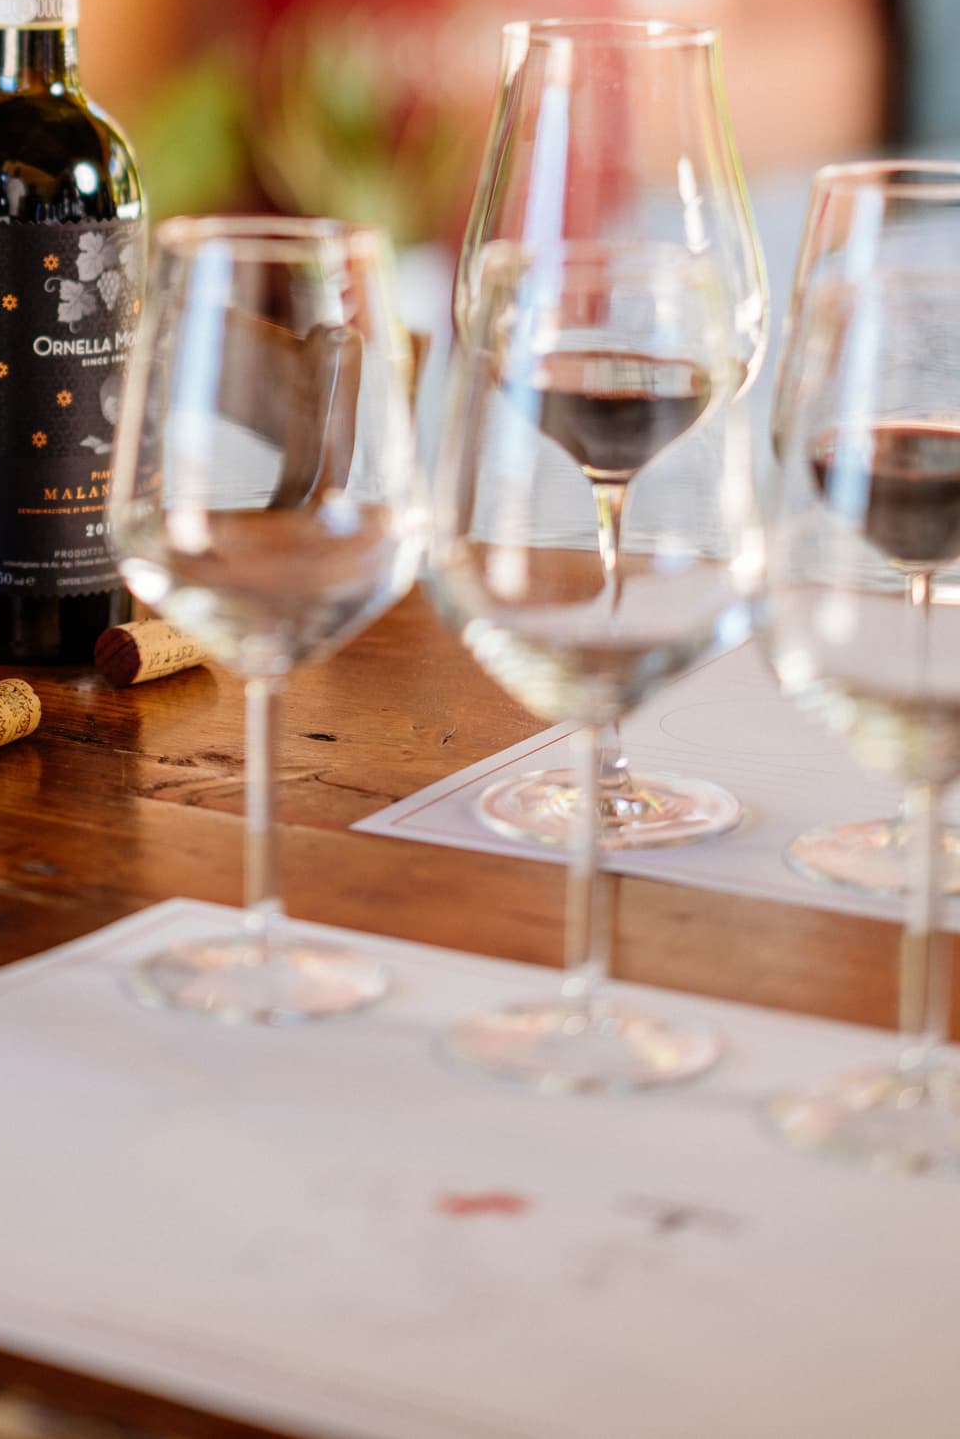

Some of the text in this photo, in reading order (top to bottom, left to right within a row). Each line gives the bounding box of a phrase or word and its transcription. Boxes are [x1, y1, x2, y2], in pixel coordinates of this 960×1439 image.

[33, 336, 112, 357] ORNELLA
[81, 356, 109, 367] SINCE
[85, 521, 116, 537] 201
